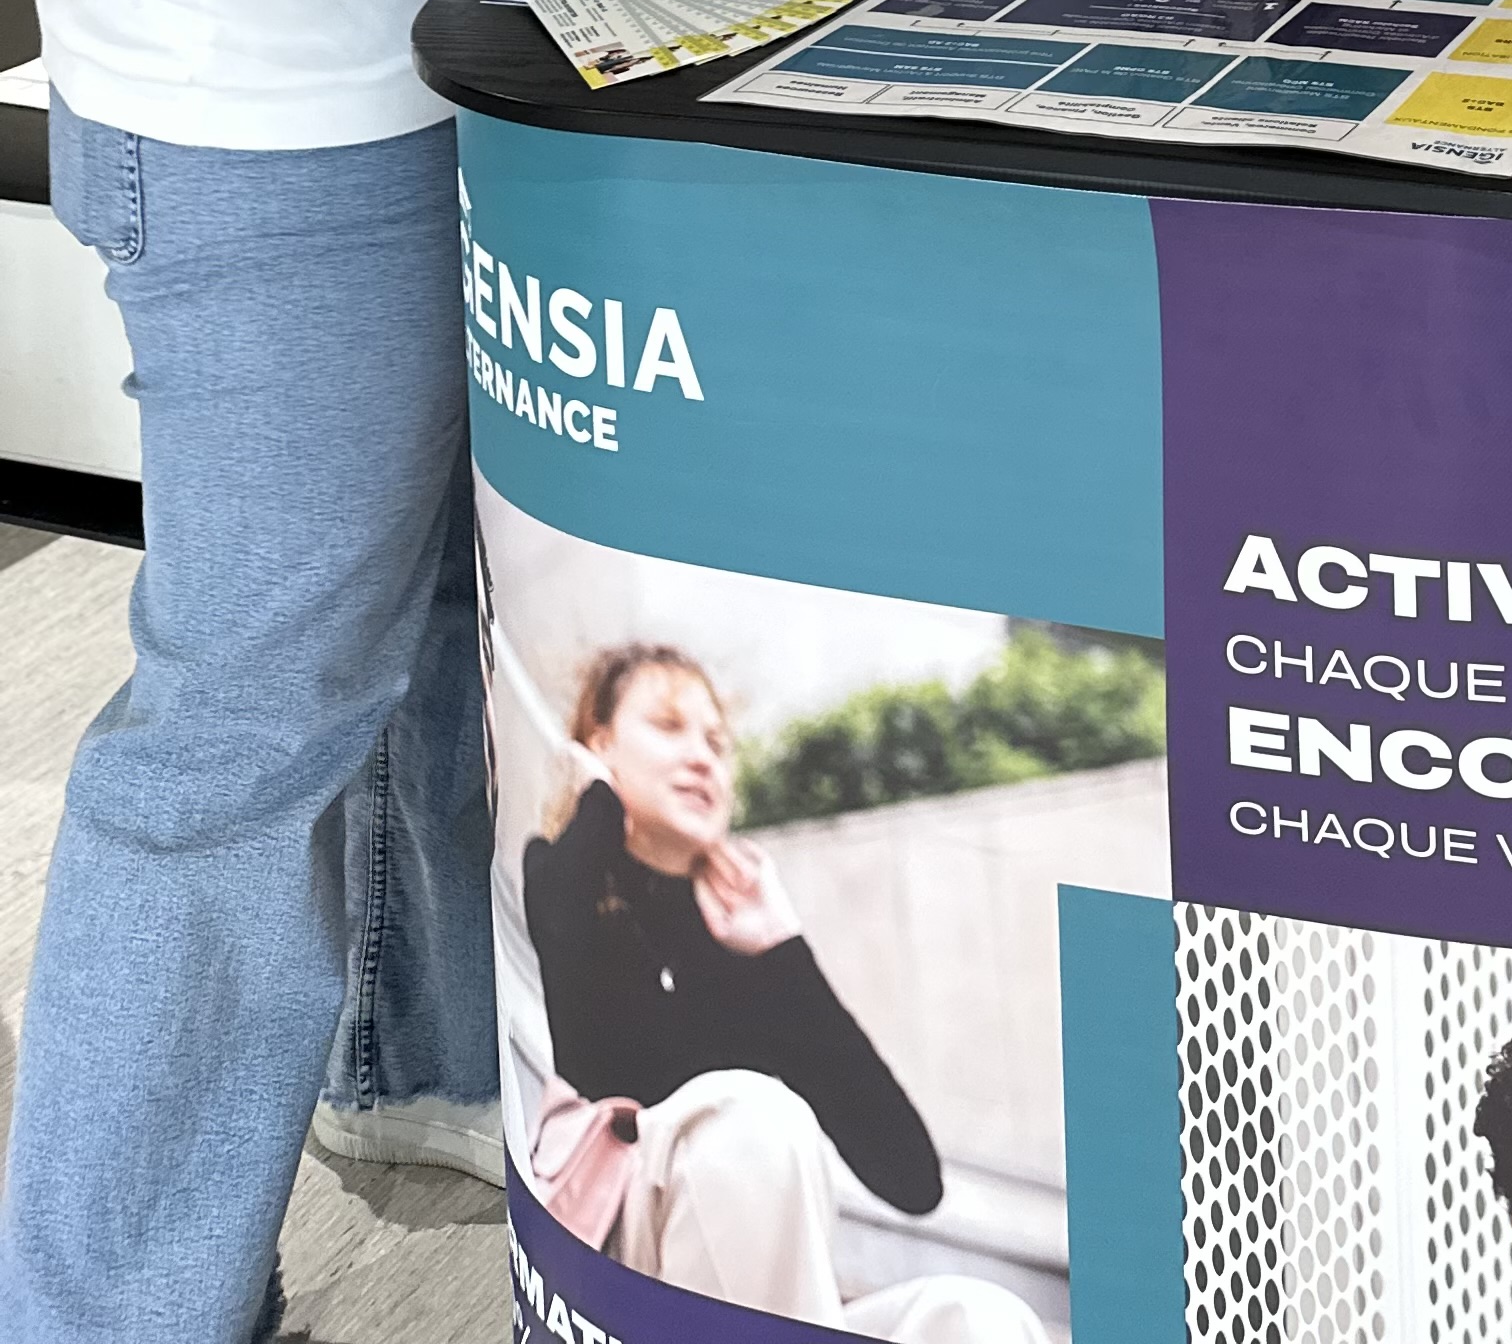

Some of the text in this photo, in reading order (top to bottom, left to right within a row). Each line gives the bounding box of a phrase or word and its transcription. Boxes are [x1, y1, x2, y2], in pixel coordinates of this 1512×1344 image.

[774, 85, 844, 98] Ressources
[789, 80, 848, 91] Humaines
[1035, 104, 1141, 119] Gestion, Finance,
[1057, 101, 1137, 112] Comptabilité
[1393, 117, 1506, 134] FONDAMENTAUX
[1411, 142, 1504, 162] IGENSIA
[1433, 140, 1508, 153] ALTERNANCE
[1225, 633, 1507, 705] CHAQUE
[1228, 800, 1478, 865] CHAQUE
